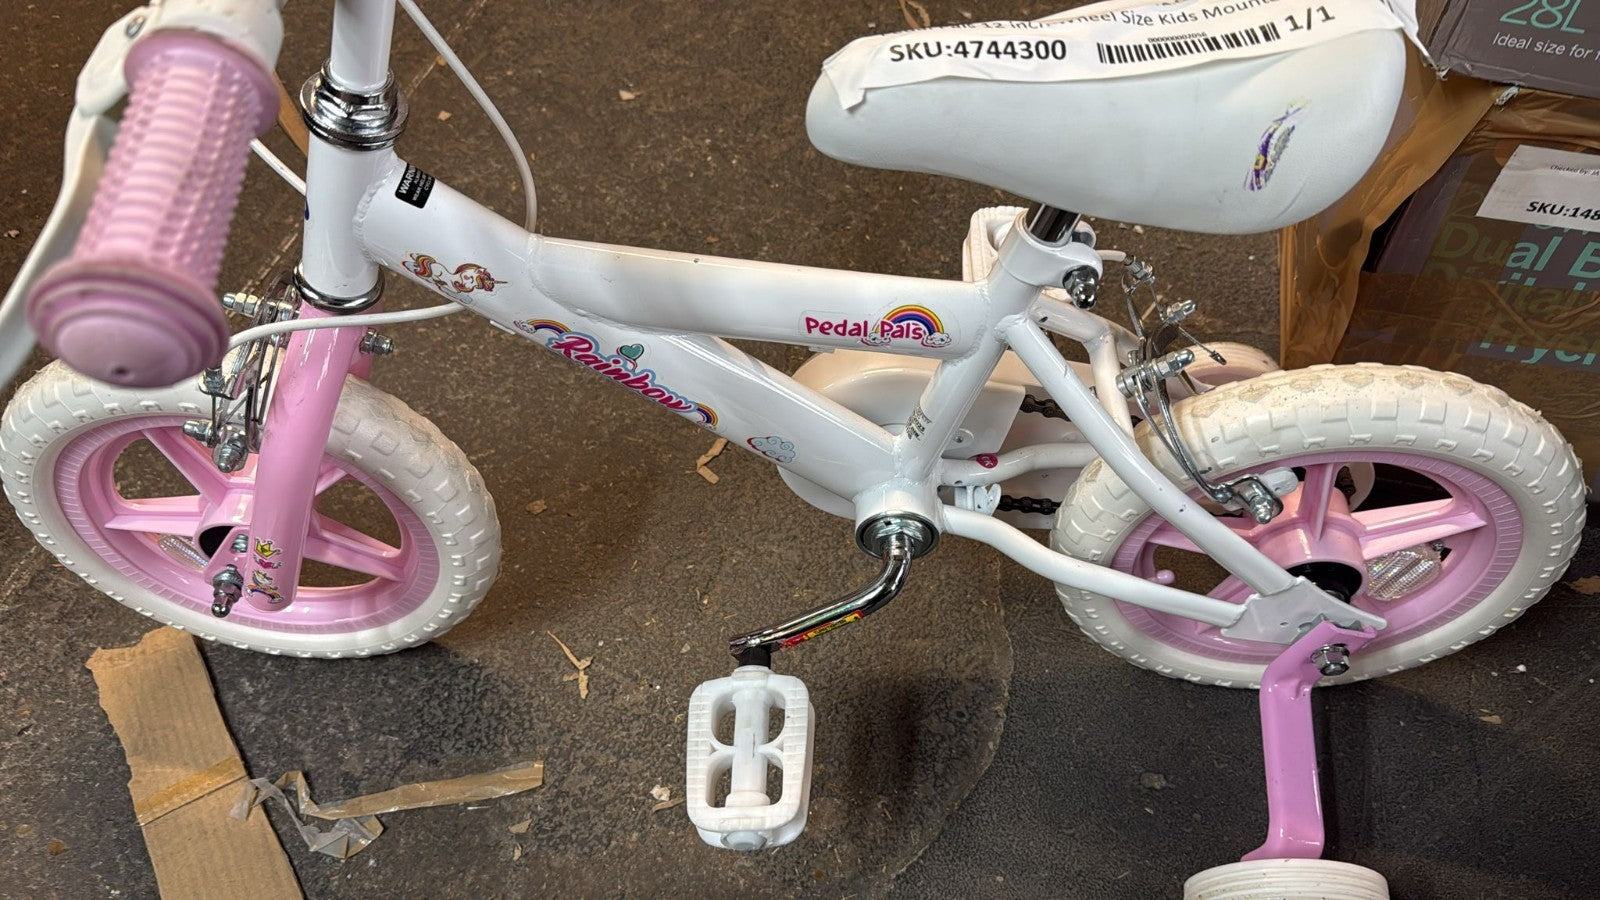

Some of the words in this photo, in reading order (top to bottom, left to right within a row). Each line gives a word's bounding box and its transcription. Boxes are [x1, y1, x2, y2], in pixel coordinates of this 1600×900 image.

[1120, 10, 1154, 26] Size
[1158, 11, 1199, 25] Kids
[1284, 5, 1336, 32] 1/1
[889, 39, 1067, 62] SKU:4744300
[1492, 32, 1533, 50] Ideal
[1534, 39, 1566, 55] size
[1569, 44, 1594, 59] for
[804, 316, 869, 338] Pedal
[879, 319, 927, 341] Pals
[549, 335, 694, 411] Rainbow
